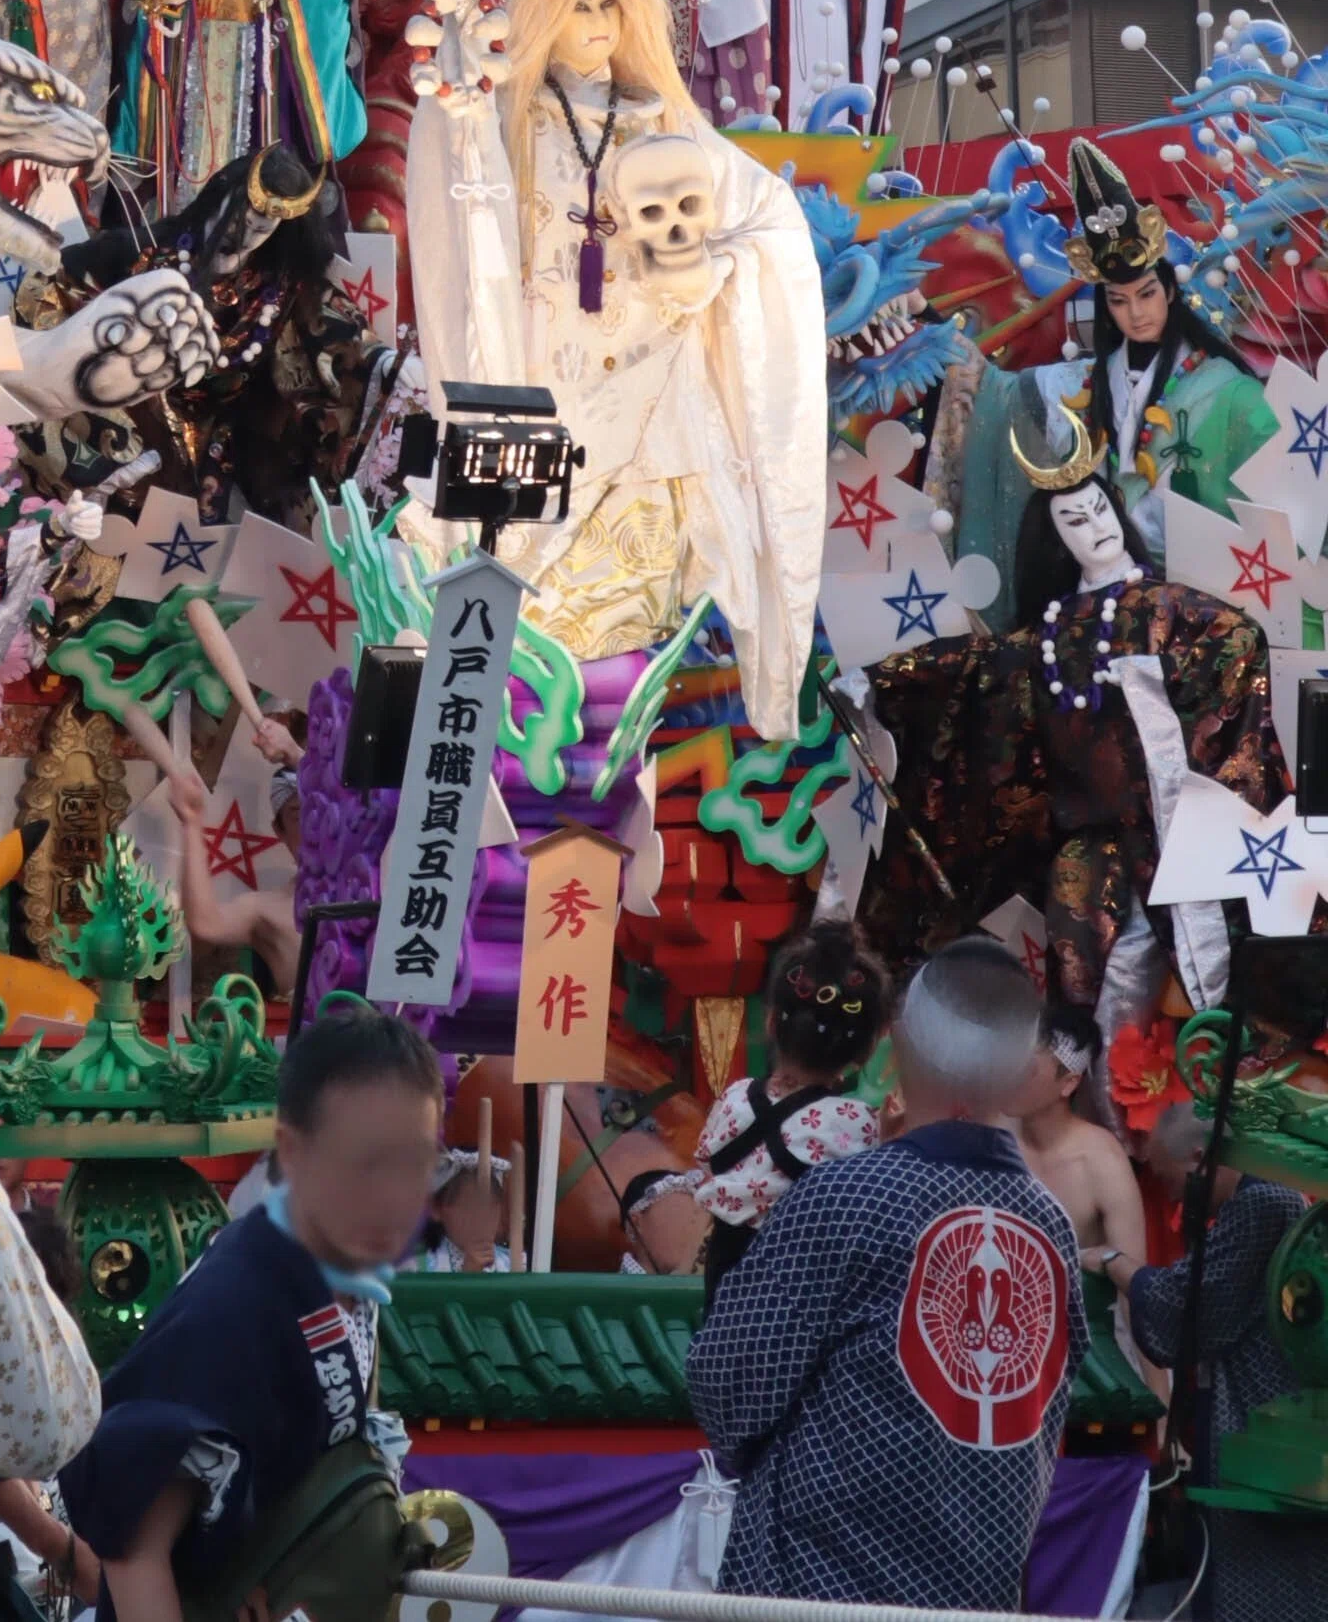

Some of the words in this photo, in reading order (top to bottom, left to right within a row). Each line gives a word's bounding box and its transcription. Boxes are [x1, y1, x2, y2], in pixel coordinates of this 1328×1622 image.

[394, 597, 495, 979] 八戸市職員互助会
[536, 877, 603, 1037] 秀作
